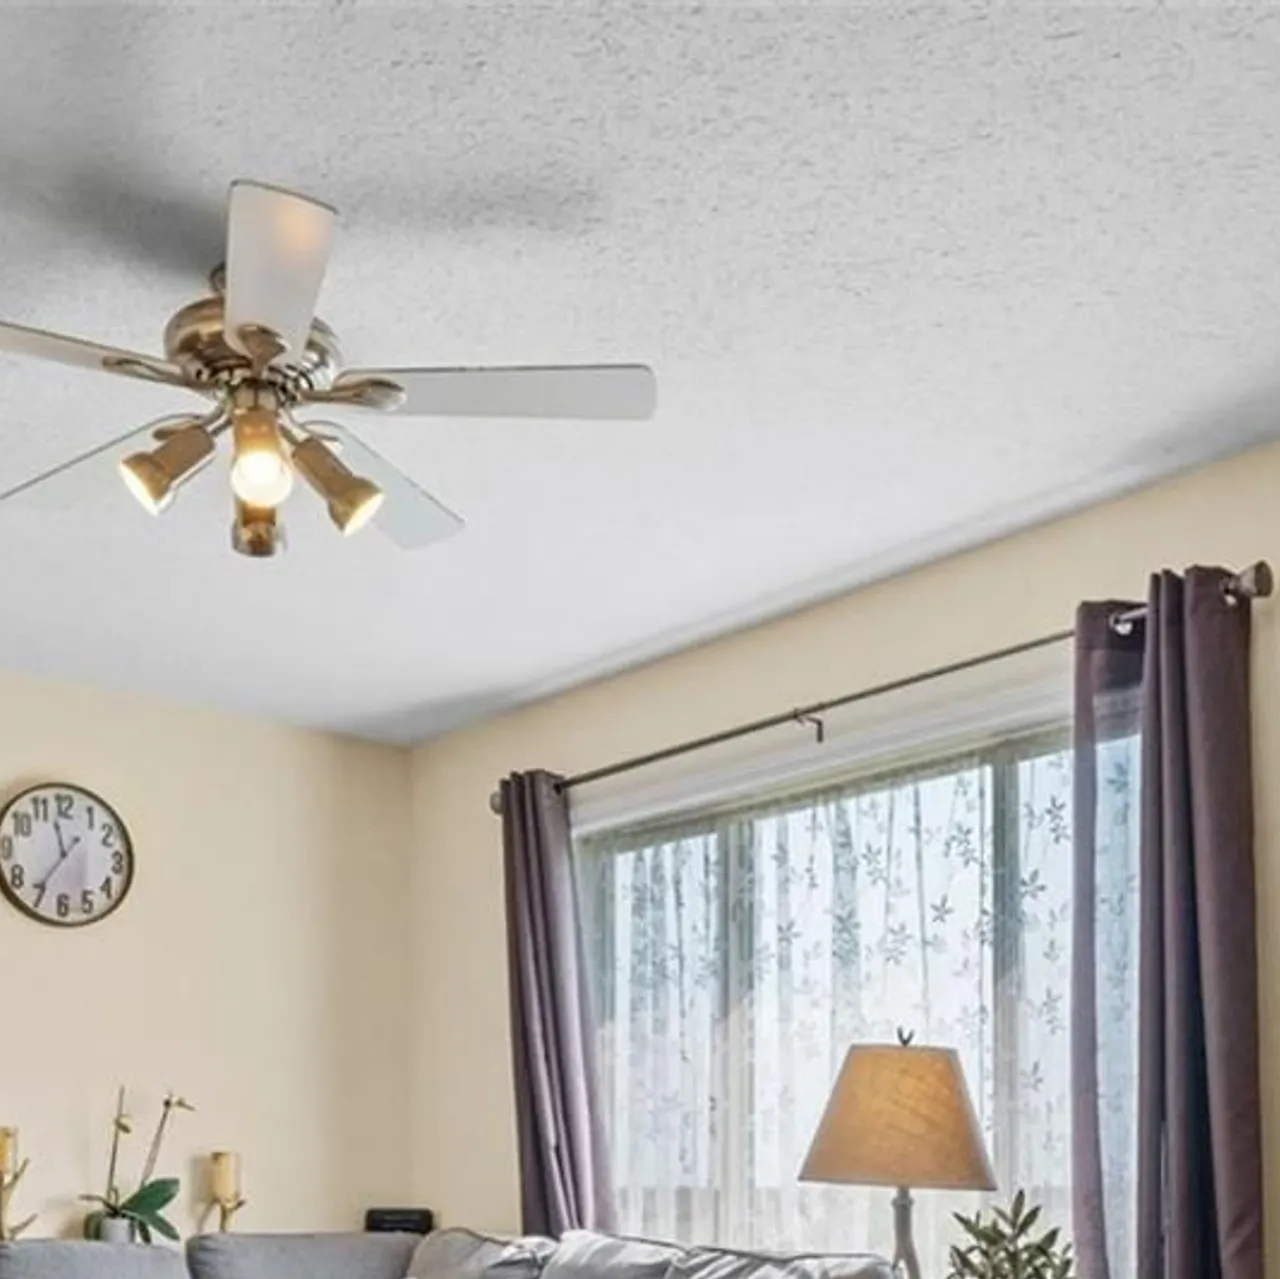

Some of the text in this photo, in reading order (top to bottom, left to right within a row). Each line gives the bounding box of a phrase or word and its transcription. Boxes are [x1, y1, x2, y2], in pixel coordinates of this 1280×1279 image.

[30, 796, 48, 822] 11
[55, 793, 74, 819] 12
[86, 806, 94, 830] 1
[12, 811, 32, 837] 10
[102, 823, 114, 847] 2
[1, 836, 13, 860] 9
[112, 851, 123, 874] 3
[11, 864, 24, 888] 8
[100, 877, 112, 899] 4
[33, 882, 46, 908] 7
[57, 893, 69, 917] 6
[81, 890, 94, 913] 5
